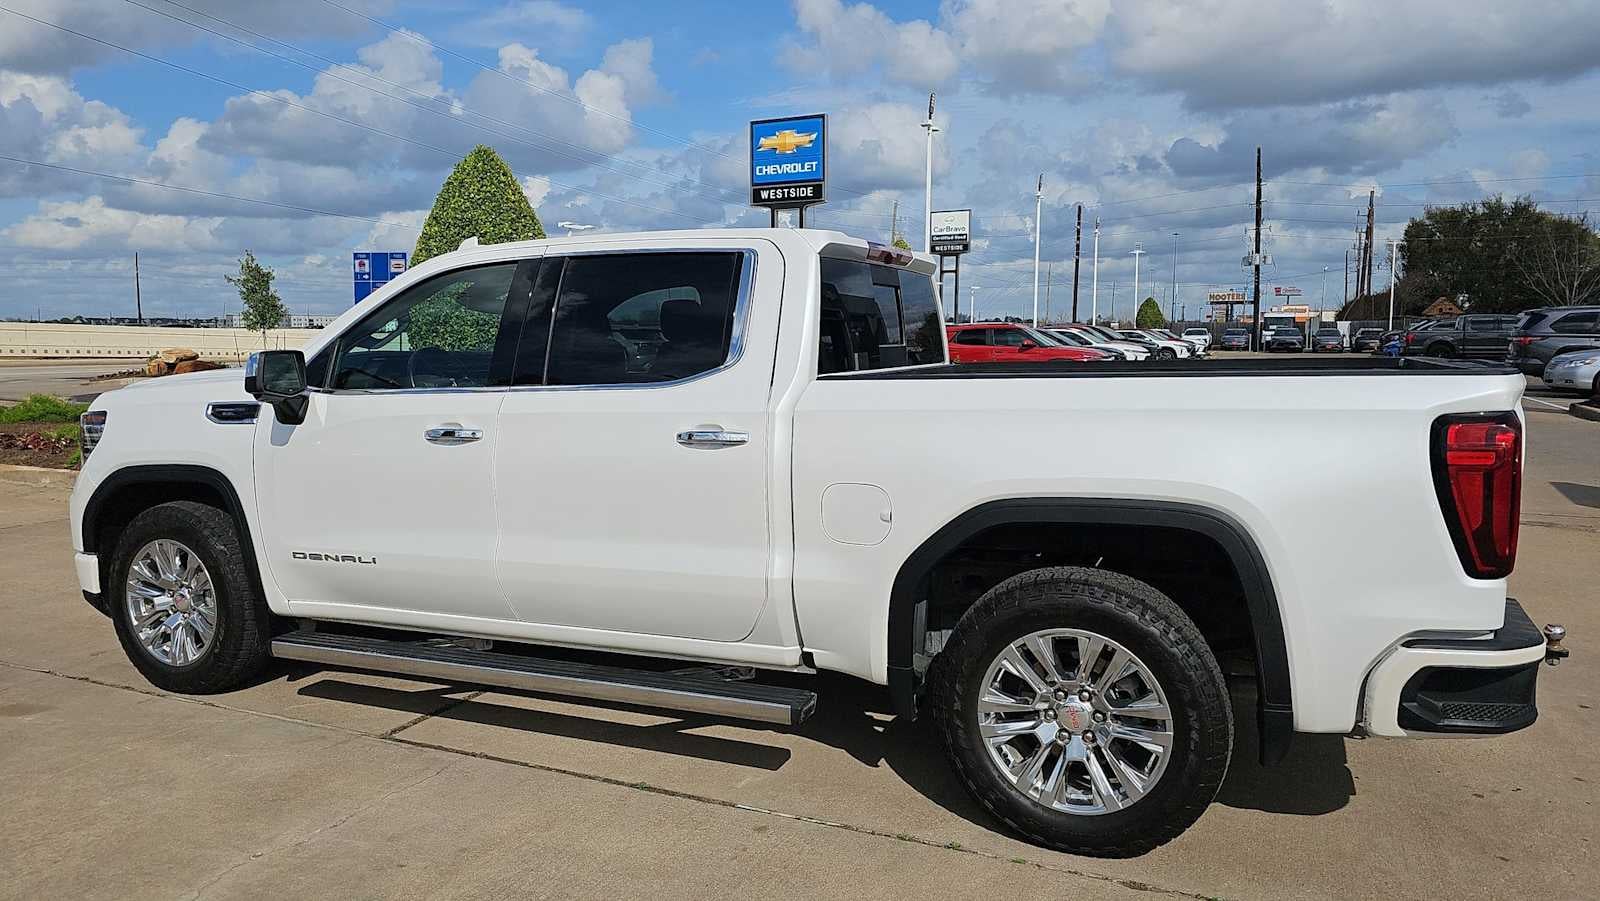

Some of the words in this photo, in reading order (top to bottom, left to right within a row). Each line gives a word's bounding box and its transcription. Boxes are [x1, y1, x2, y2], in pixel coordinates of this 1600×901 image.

[756, 161, 818, 176] CHEVROLET
[760, 187, 814, 199] WESTSIDE
[933, 225, 966, 233] CarBravo
[1208, 292, 1246, 301] HOOTERS
[292, 551, 377, 565] DENALI
